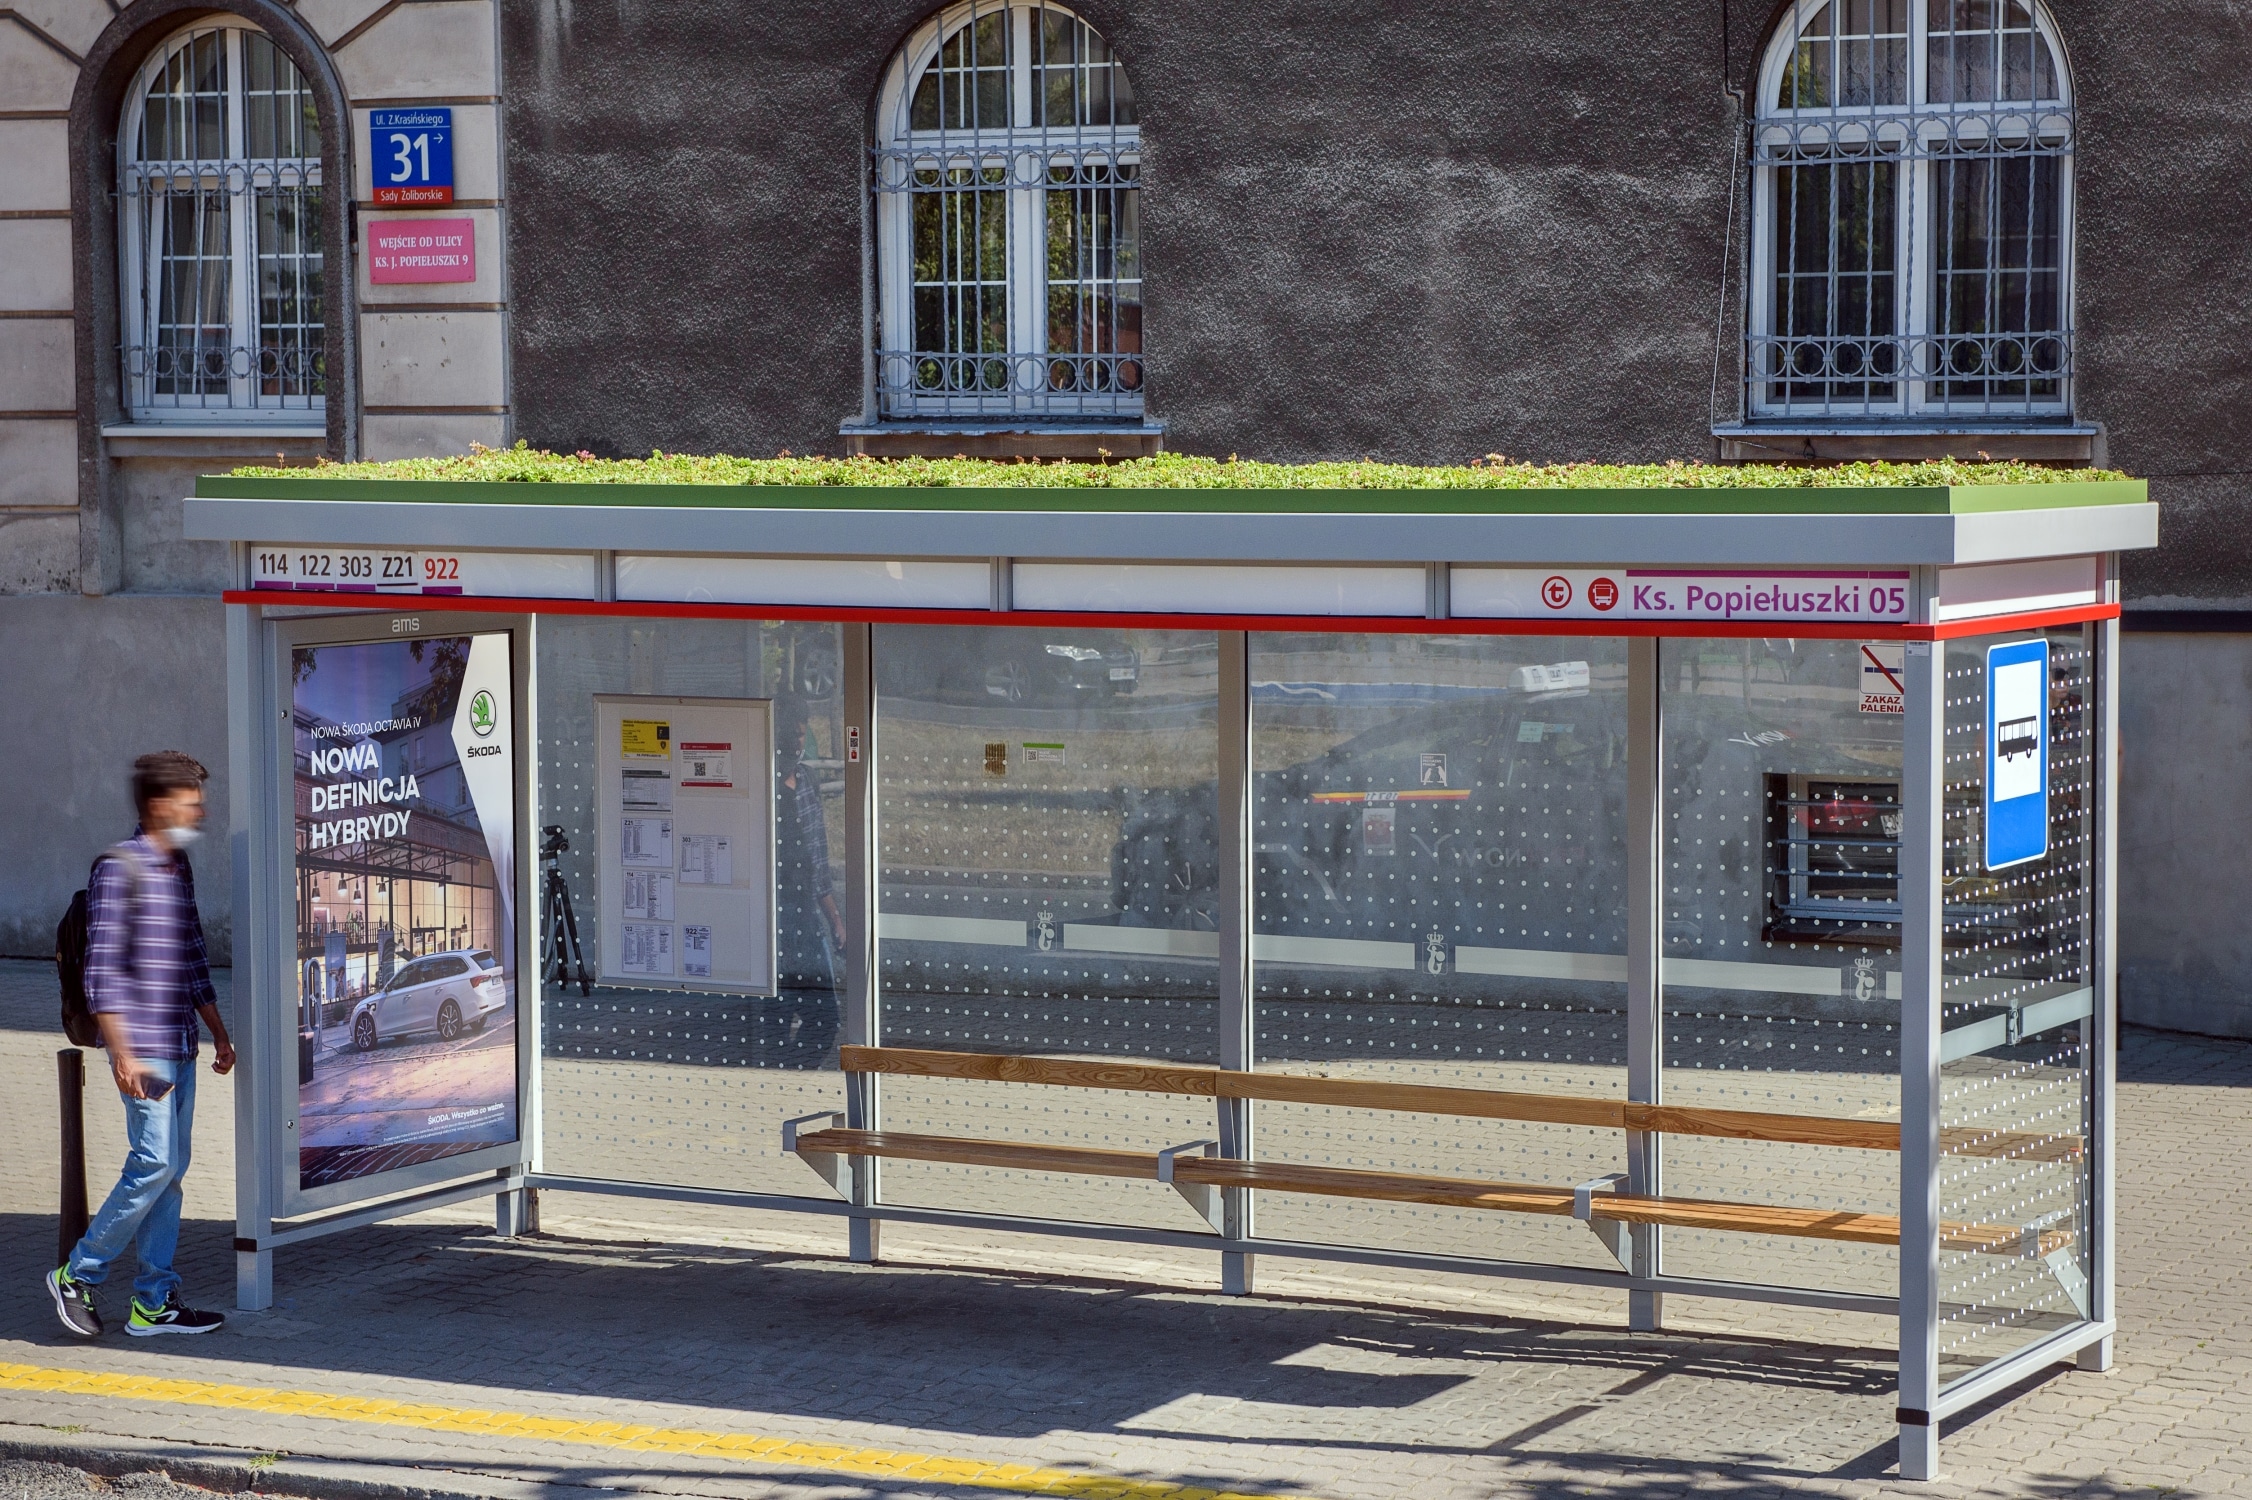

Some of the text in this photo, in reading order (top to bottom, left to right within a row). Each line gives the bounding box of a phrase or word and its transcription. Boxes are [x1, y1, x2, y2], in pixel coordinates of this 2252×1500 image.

[376, 111, 444, 126] Ul. Z.Krasińskiego
[390, 133, 430, 182] 31
[380, 187, 443, 203] Sady Żoliborskie
[379, 234, 463, 250] WEJŚCIE OD ULICY
[375, 254, 469, 270] KS. J. POPIEŁUSZKI 9
[259, 553, 459, 580] 114 122 303 Z21 922
[1633, 584, 1905, 618] Ks. Popiełuszki 05
[391, 617, 420, 633] ams
[1865, 695, 1901, 704] ZAKAZ
[1860, 703, 1904, 713] PALENIA
[311, 724, 341, 740] NOWA
[342, 721, 373, 737] ŠKODA
[374, 718, 412, 732] OCTAVIA
[467, 745, 502, 758] ŠKODA
[311, 744, 379, 776] NOWA
[311, 774, 420, 813] DEFINICJA
[312, 809, 412, 849] HYBRYDY
[427, 1113, 450, 1125] ŠKODA.
[451, 1108, 479, 1120] Wszystko
